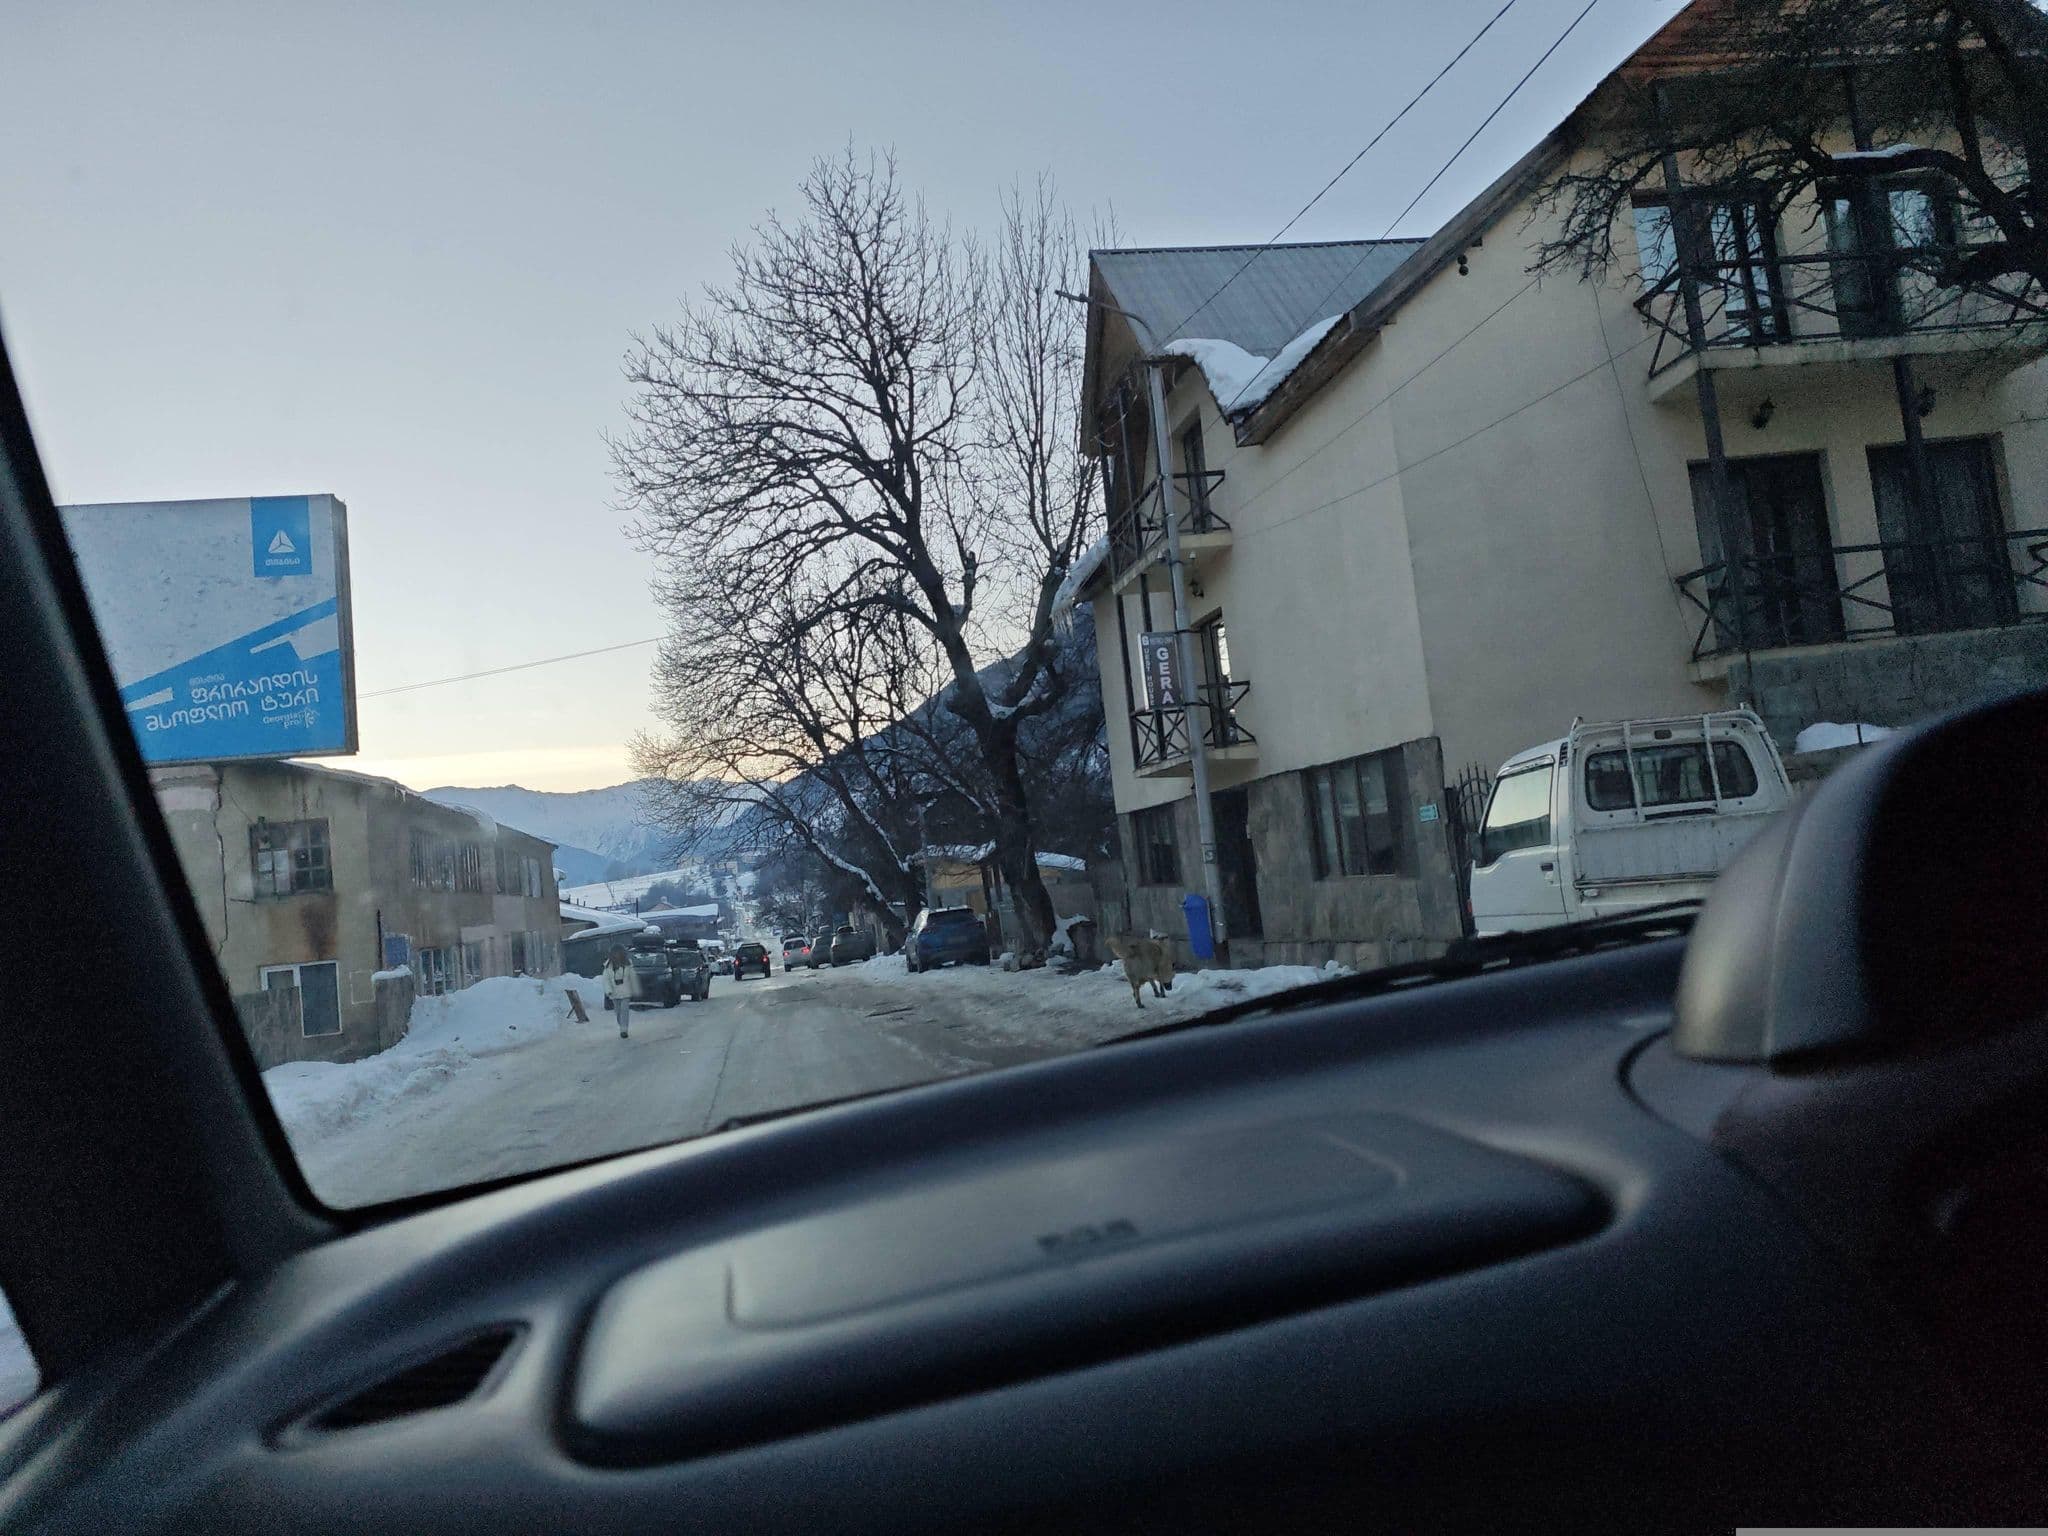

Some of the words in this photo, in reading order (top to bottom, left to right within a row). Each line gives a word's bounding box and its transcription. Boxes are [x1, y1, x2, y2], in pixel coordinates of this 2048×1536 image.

[191, 670, 318, 704] ფრირაიდის
[1157, 647, 1175, 704] GERA
[144, 700, 249, 731] მსოფლიო
[261, 688, 319, 711] ტური
